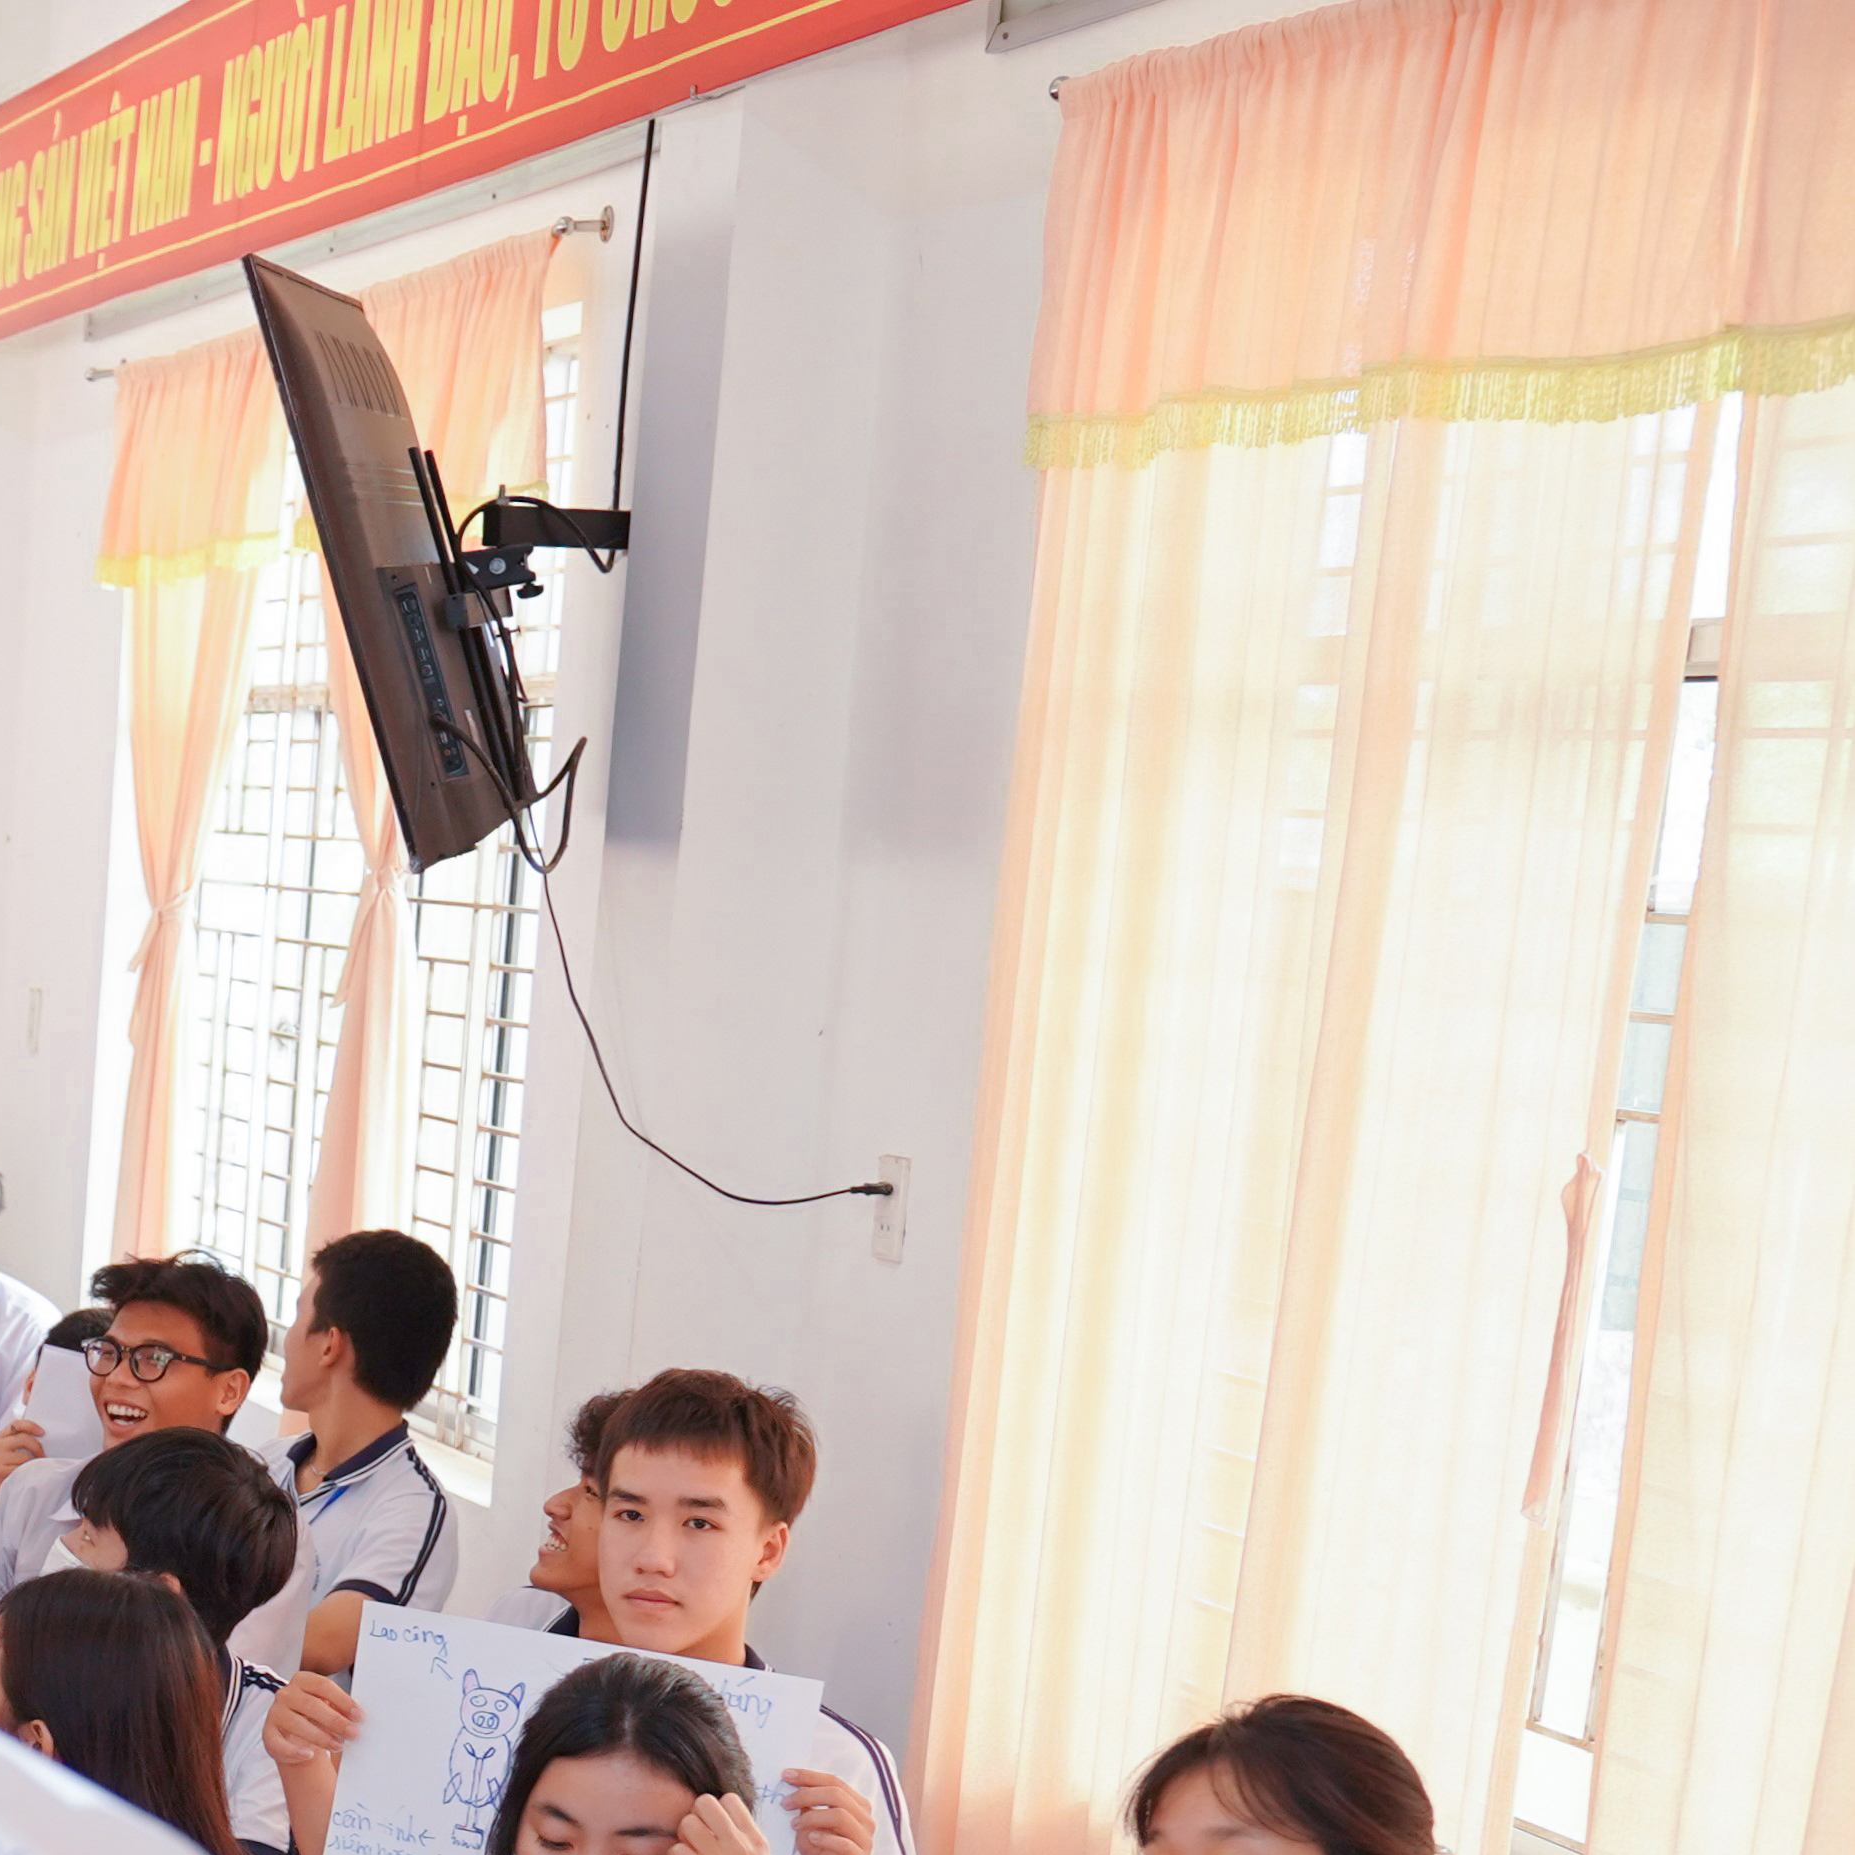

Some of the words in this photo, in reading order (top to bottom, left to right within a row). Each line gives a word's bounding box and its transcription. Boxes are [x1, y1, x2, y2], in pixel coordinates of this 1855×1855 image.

[23, 110, 77, 280] SẢN
[74, 90, 137, 269] VIỆT
[129, 75, 201, 236] NAM
[213, 4, 327, 205] NGƯỜI
[369, 1619, 397, 1642] Lao
[403, 1625, 449, 1658] công
